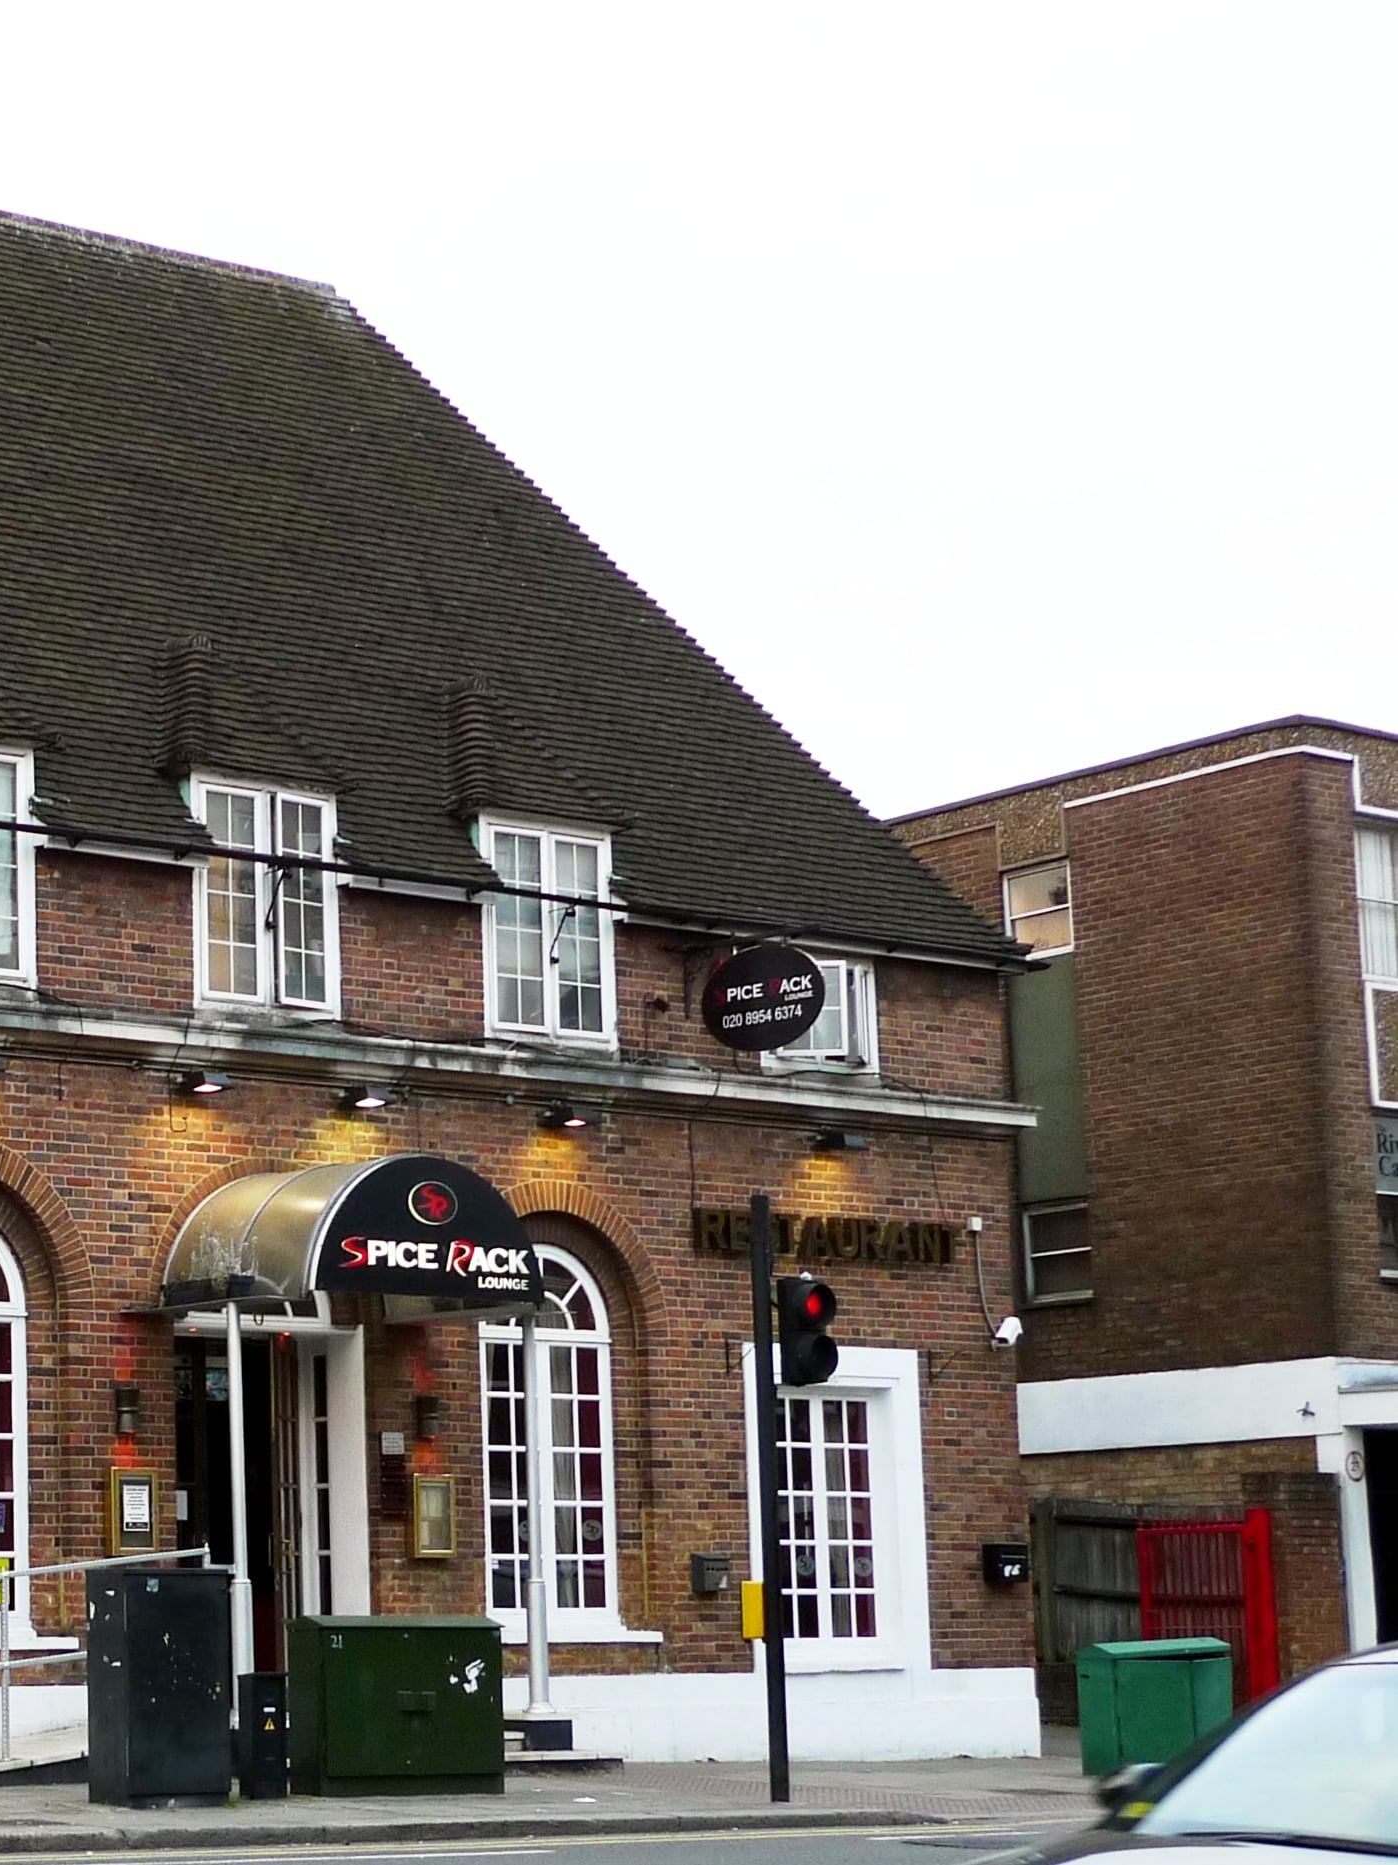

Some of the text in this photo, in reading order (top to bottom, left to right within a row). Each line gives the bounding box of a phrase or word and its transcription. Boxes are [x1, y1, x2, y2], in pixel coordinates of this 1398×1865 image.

[784, 990, 814, 1001] LOUNGE
[722, 1003, 803, 1029] 020 8954 6374
[695, 1208, 956, 1263] RETAURANT
[339, 1236, 530, 1277] SPICE RACK
[477, 1275, 530, 1291] LOUNGE
[330, 1634, 343, 1648] 21
